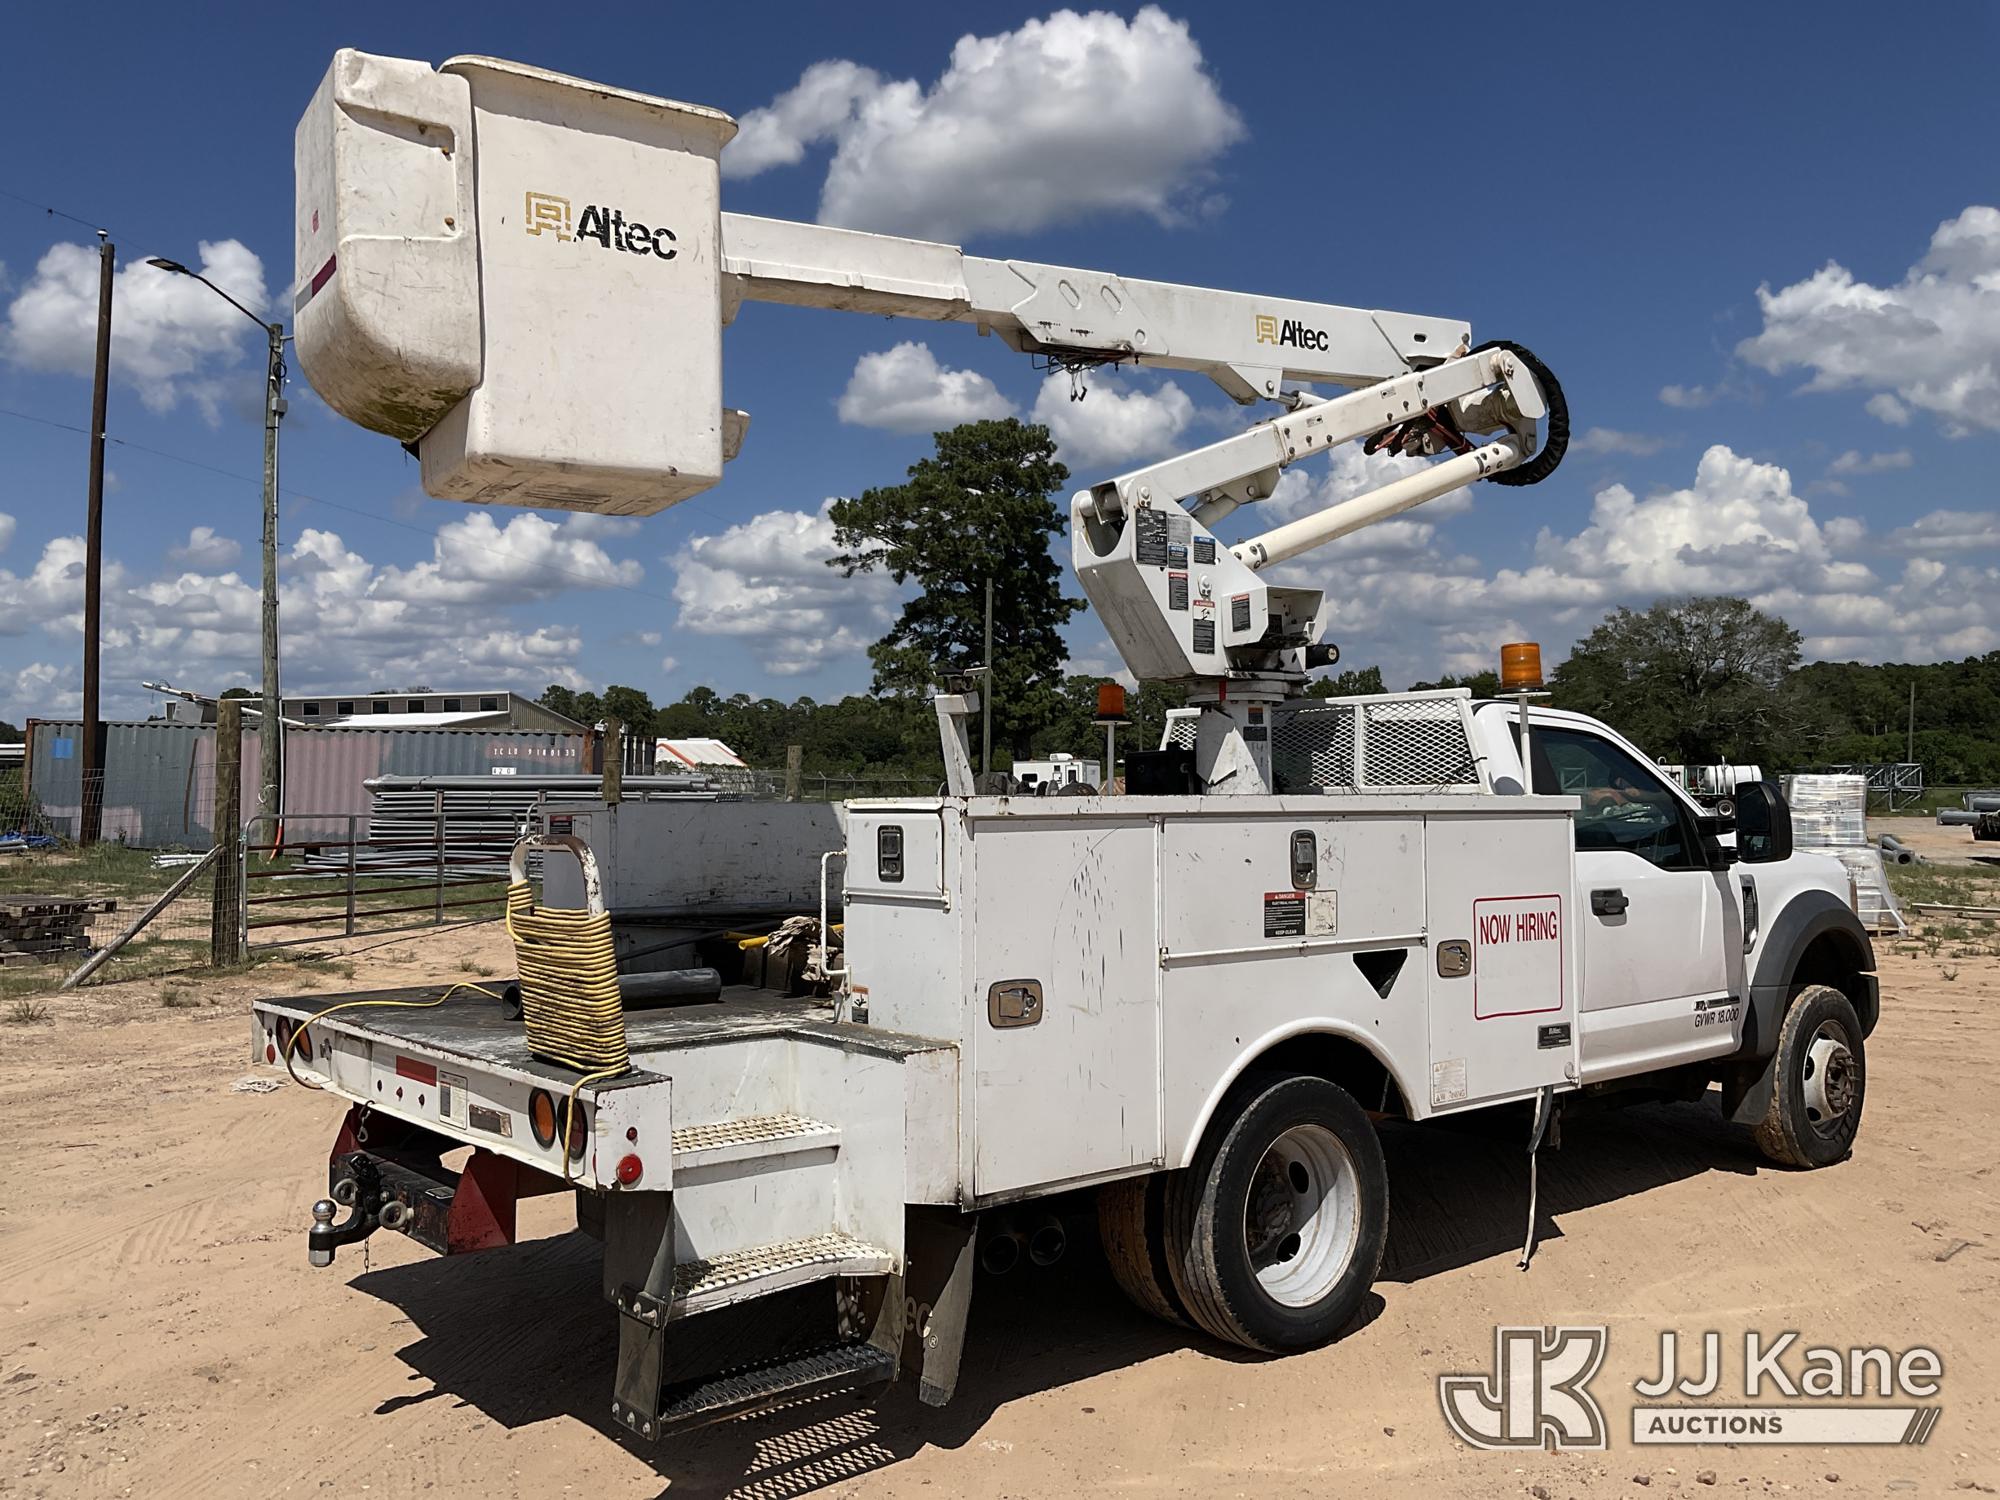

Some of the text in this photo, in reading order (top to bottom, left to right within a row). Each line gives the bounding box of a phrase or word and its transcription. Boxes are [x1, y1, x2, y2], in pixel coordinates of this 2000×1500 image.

[574, 205, 677, 260] Altec
[1279, 319, 1328, 351] Altec
[1480, 911, 1557, 945] NOW HIRING
[1695, 1012, 1715, 1028] GVWR
